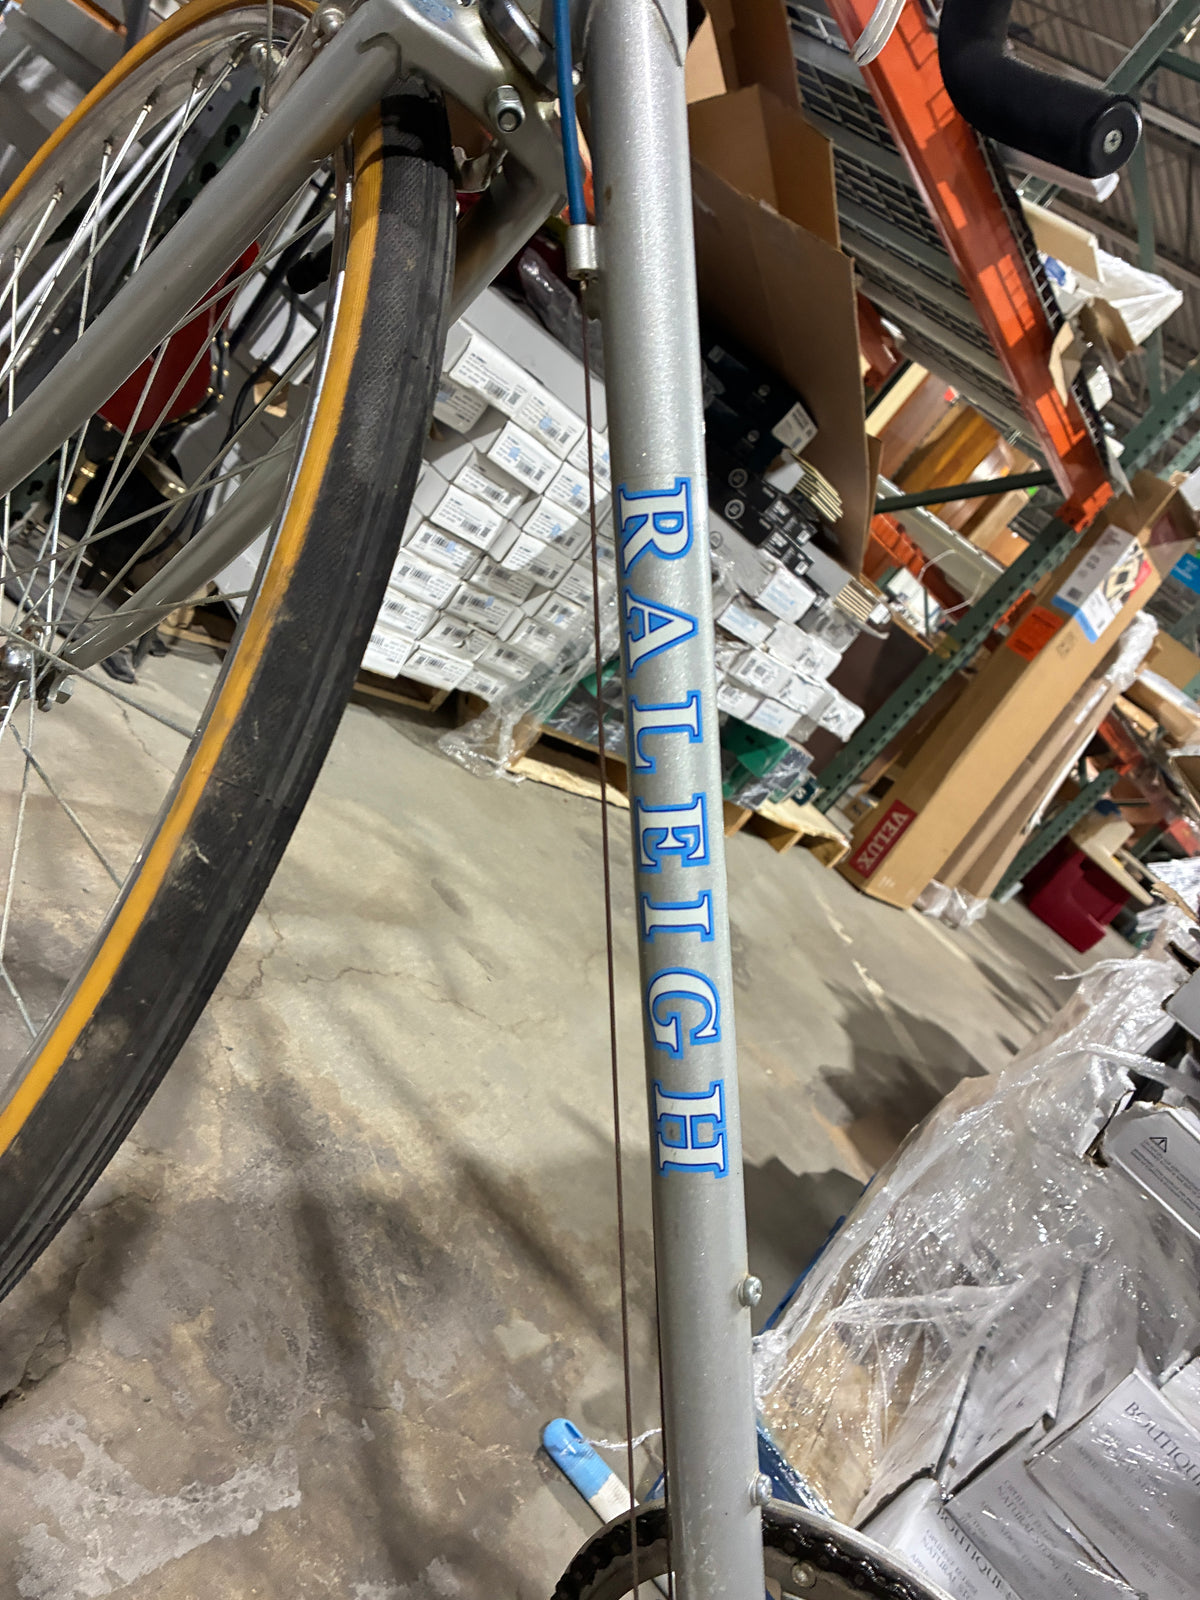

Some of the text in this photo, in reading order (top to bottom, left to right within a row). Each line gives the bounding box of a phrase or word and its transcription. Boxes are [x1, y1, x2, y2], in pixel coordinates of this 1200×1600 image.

[618, 477, 729, 1178] RALEIGH
[857, 811, 909, 871] VELUX
[1124, 1401, 1200, 1486] BOUTIQU
